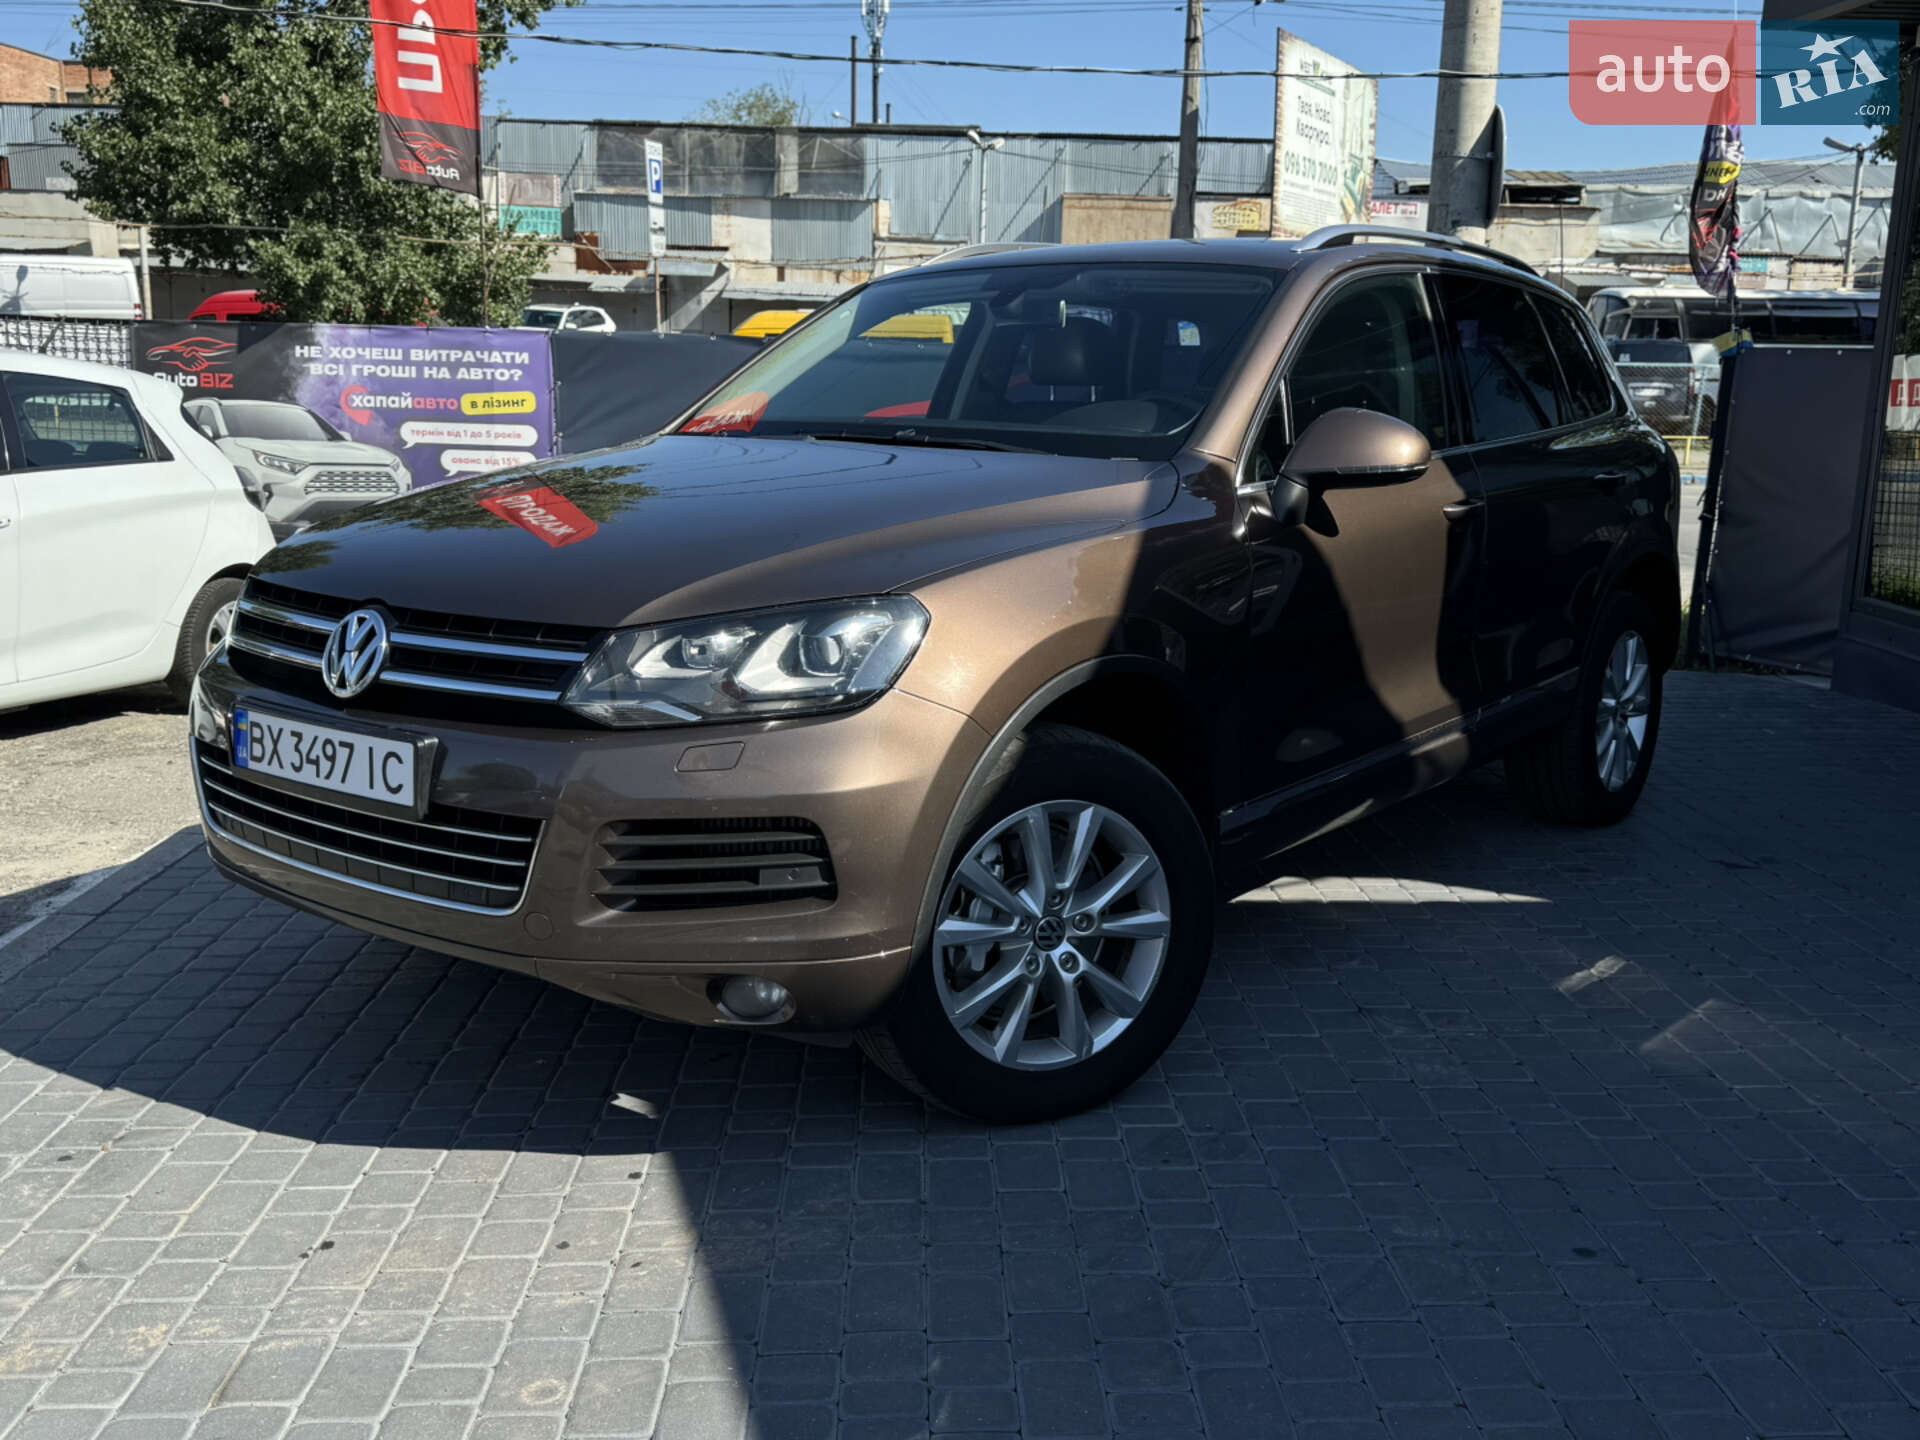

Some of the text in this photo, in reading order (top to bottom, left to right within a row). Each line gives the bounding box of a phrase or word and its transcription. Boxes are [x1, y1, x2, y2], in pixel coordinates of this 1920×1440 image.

[1284, 150, 1300, 176] 096
[1302, 155, 1317, 180] 370
[651, 160, 661, 192] P
[295, 345, 530, 365] НЕ ХОЧЕШ ВИТРАЧАТИ
[309, 364, 523, 382] ВСІ ГРОШІ НА АВТО?
[470, 401, 479, 409] в
[482, 397, 528, 409] лізинг
[411, 429, 444, 438] термін
[447, 429, 461, 438] від
[470, 431, 483, 439] до
[485, 430, 492, 439] 5
[494, 431, 522, 440] років
[484, 457, 500, 466] від
[250, 721, 404, 795] BX 3497 IC
